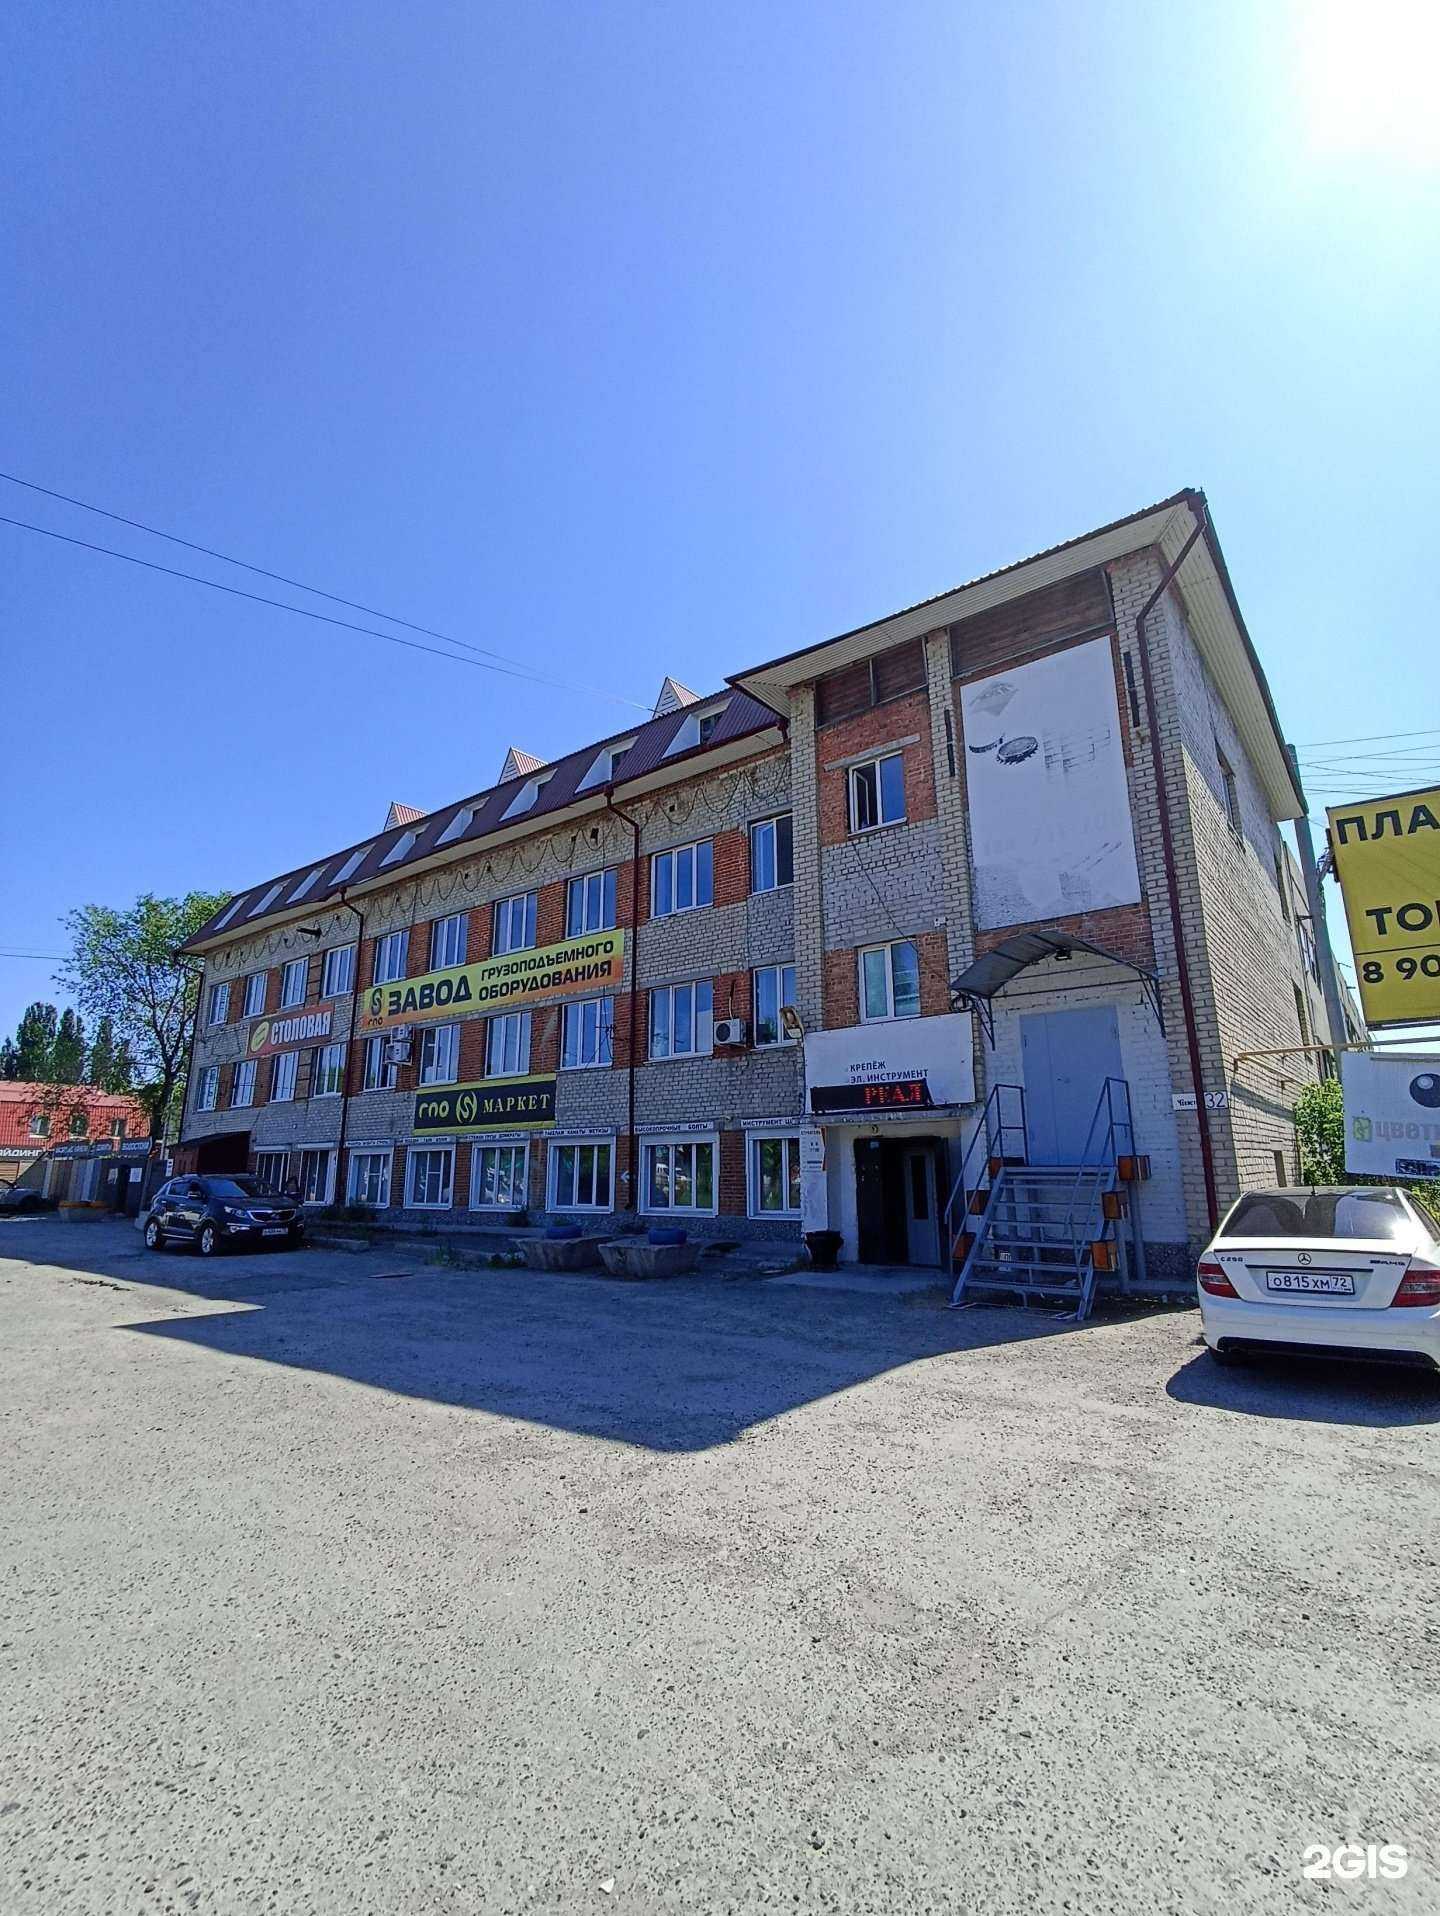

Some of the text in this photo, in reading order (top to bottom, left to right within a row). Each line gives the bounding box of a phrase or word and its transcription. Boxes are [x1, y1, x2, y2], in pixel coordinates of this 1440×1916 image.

[1336, 804, 1440, 845] ПЛА
[481, 940, 614, 981] ГРУЗОПОДЪЕМНОГО
[1362, 954, 1440, 984] 8 90
[388, 975, 472, 1016] ЗАВОД
[479, 960, 612, 1001] ОБОРУДОВАНИЯ
[270, 1011, 331, 1045] СТОЛОВАЯ
[850, 1061, 886, 1073] КРЕПЁЖ
[867, 1069, 928, 1083] ИНСТРУМЕНТ
[483, 1093, 550, 1113] МАРКЕТ
[1204, 1092, 1226, 1108] 32
[742, 1119, 783, 1127] ИНСТРУМЕНТ
